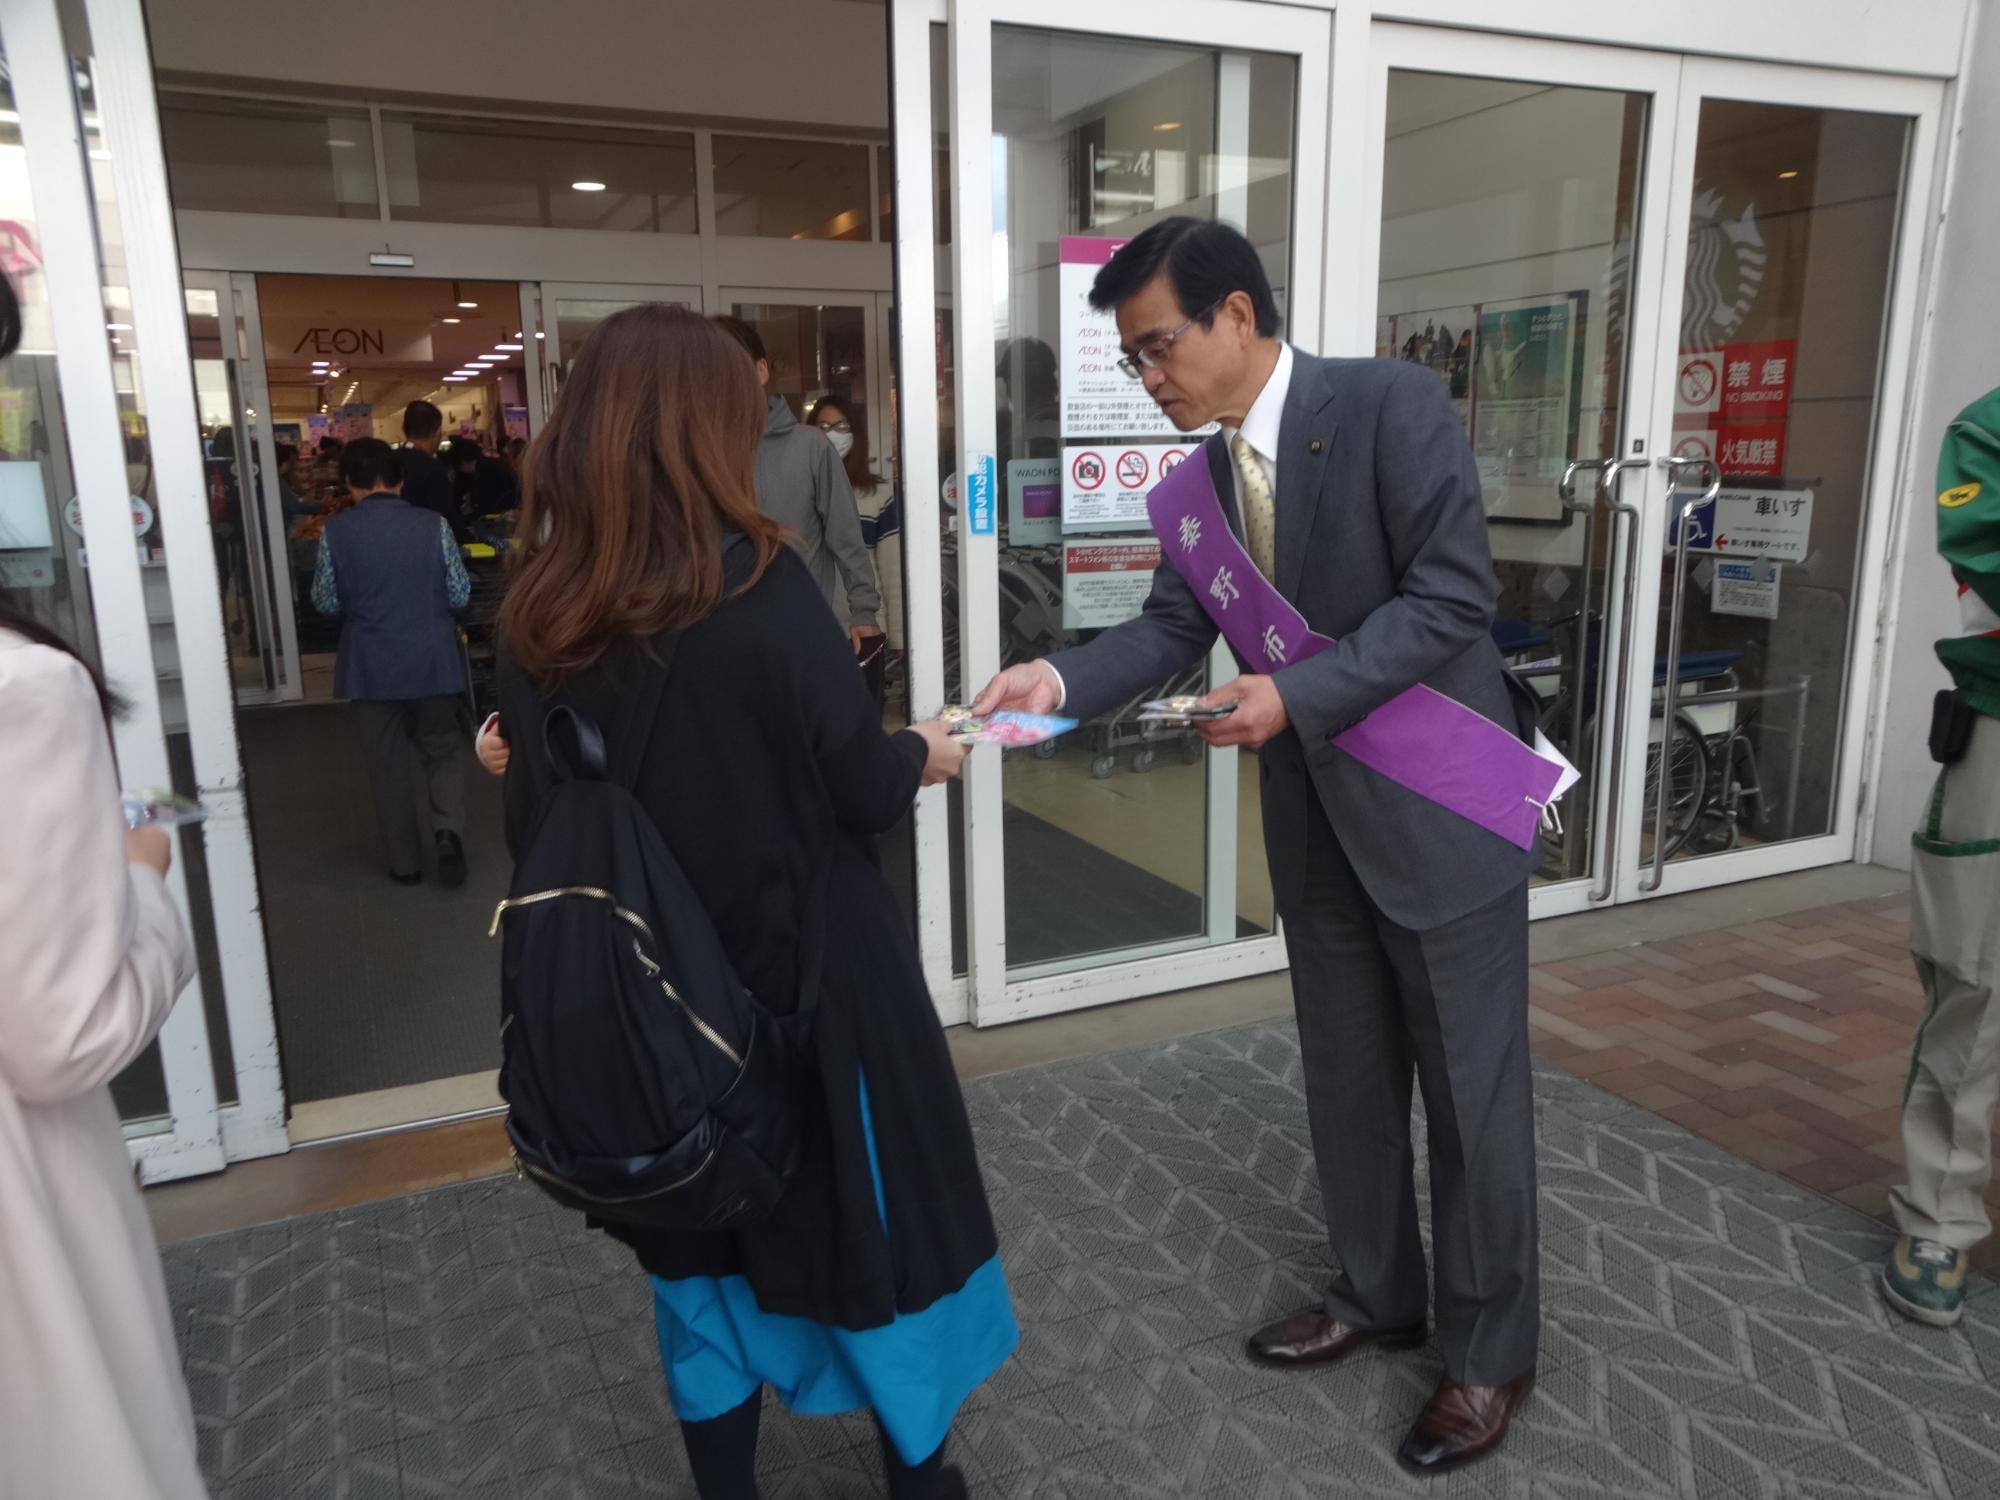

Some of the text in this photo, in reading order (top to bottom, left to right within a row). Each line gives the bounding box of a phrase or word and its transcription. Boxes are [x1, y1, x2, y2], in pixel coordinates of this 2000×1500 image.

[1727, 358, 1787, 388] 禁煙
[1725, 390, 1784, 403] NO SMOKING
[1721, 438, 1778, 465] 火気厳禁
[1755, 496, 1806, 517] 車いす
